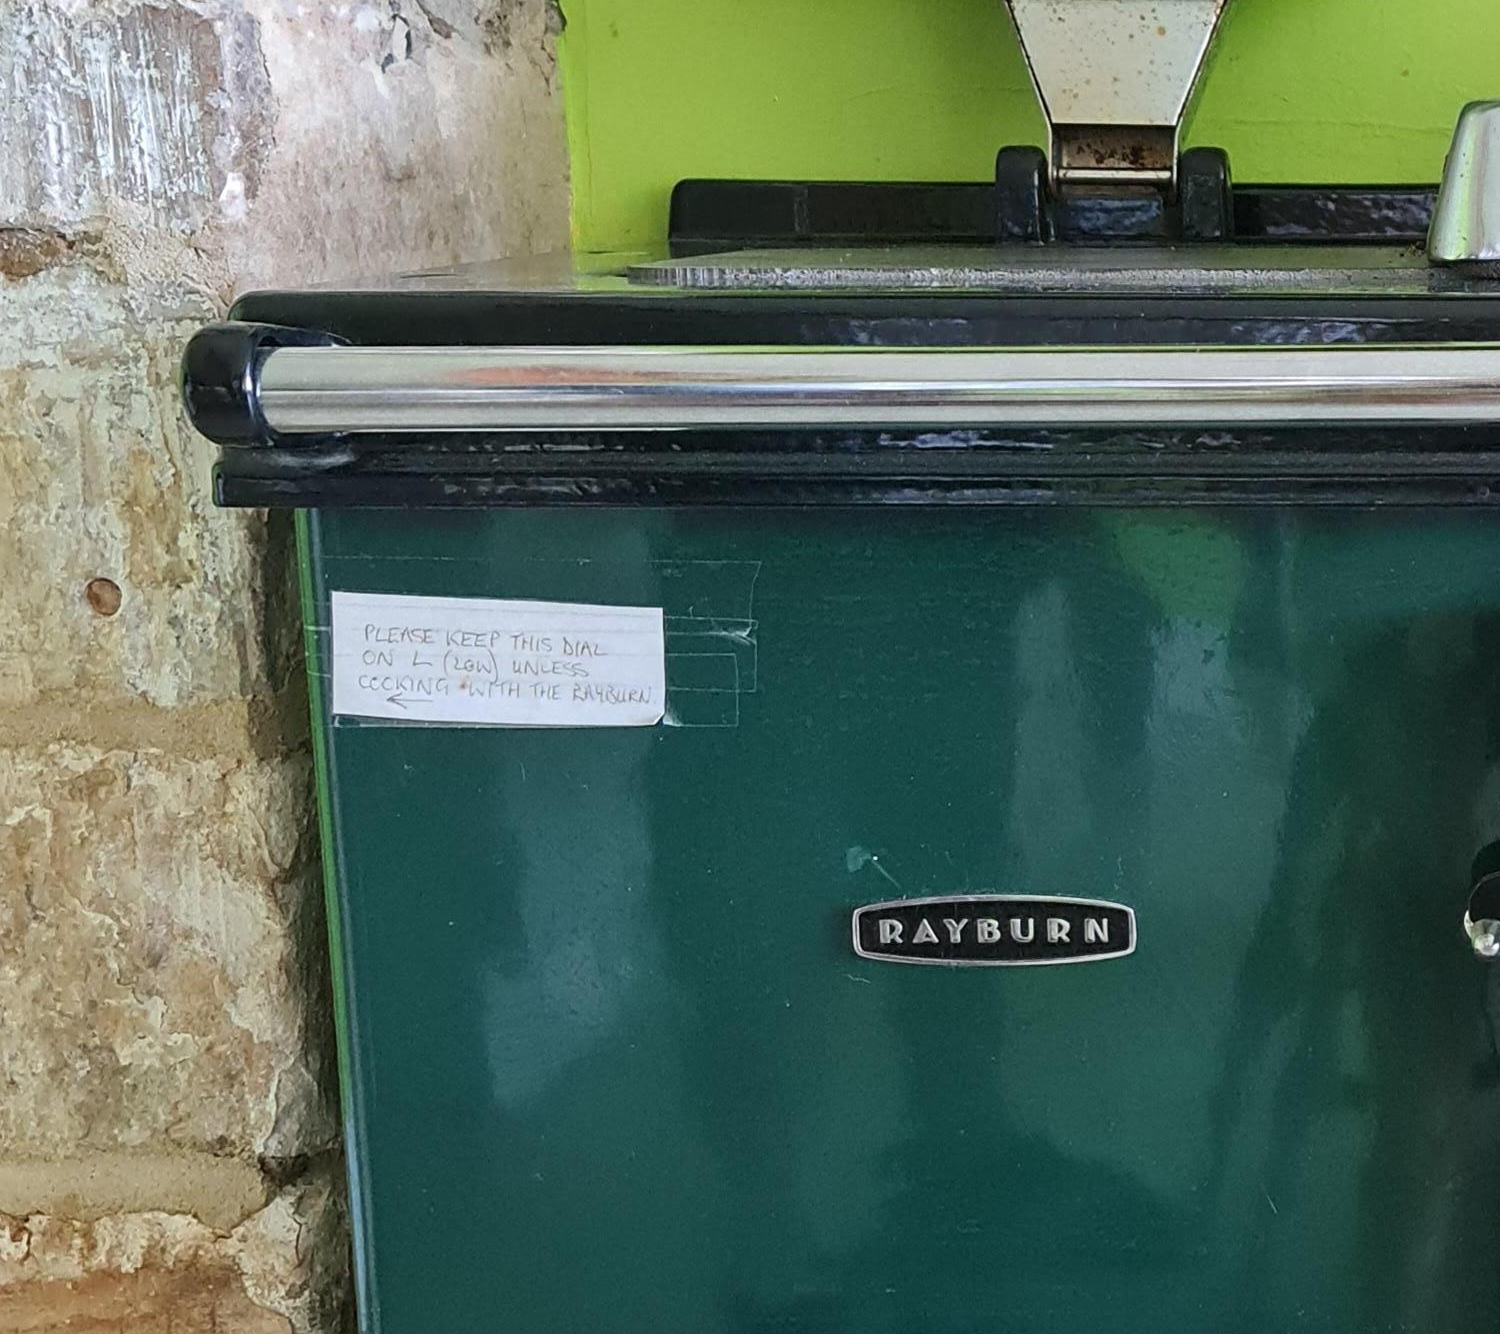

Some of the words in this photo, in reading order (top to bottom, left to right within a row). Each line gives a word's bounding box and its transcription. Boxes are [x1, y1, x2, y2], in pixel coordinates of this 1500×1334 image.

[365, 624, 435, 644] PLEASE
[446, 630, 500, 648] KEEP
[511, 633, 552, 652] THIS
[563, 636, 608, 657] DIAL
[362, 649, 394, 666] ON
[412, 650, 432, 666] L
[443, 648, 499, 685] (LOW)
[512, 660, 589, 678] UNLESS
[359, 674, 449, 695] COOKING
[469, 681, 520, 699] WITH
[529, 682, 561, 700] THE
[878, 918, 1109, 944] RAYBURN
